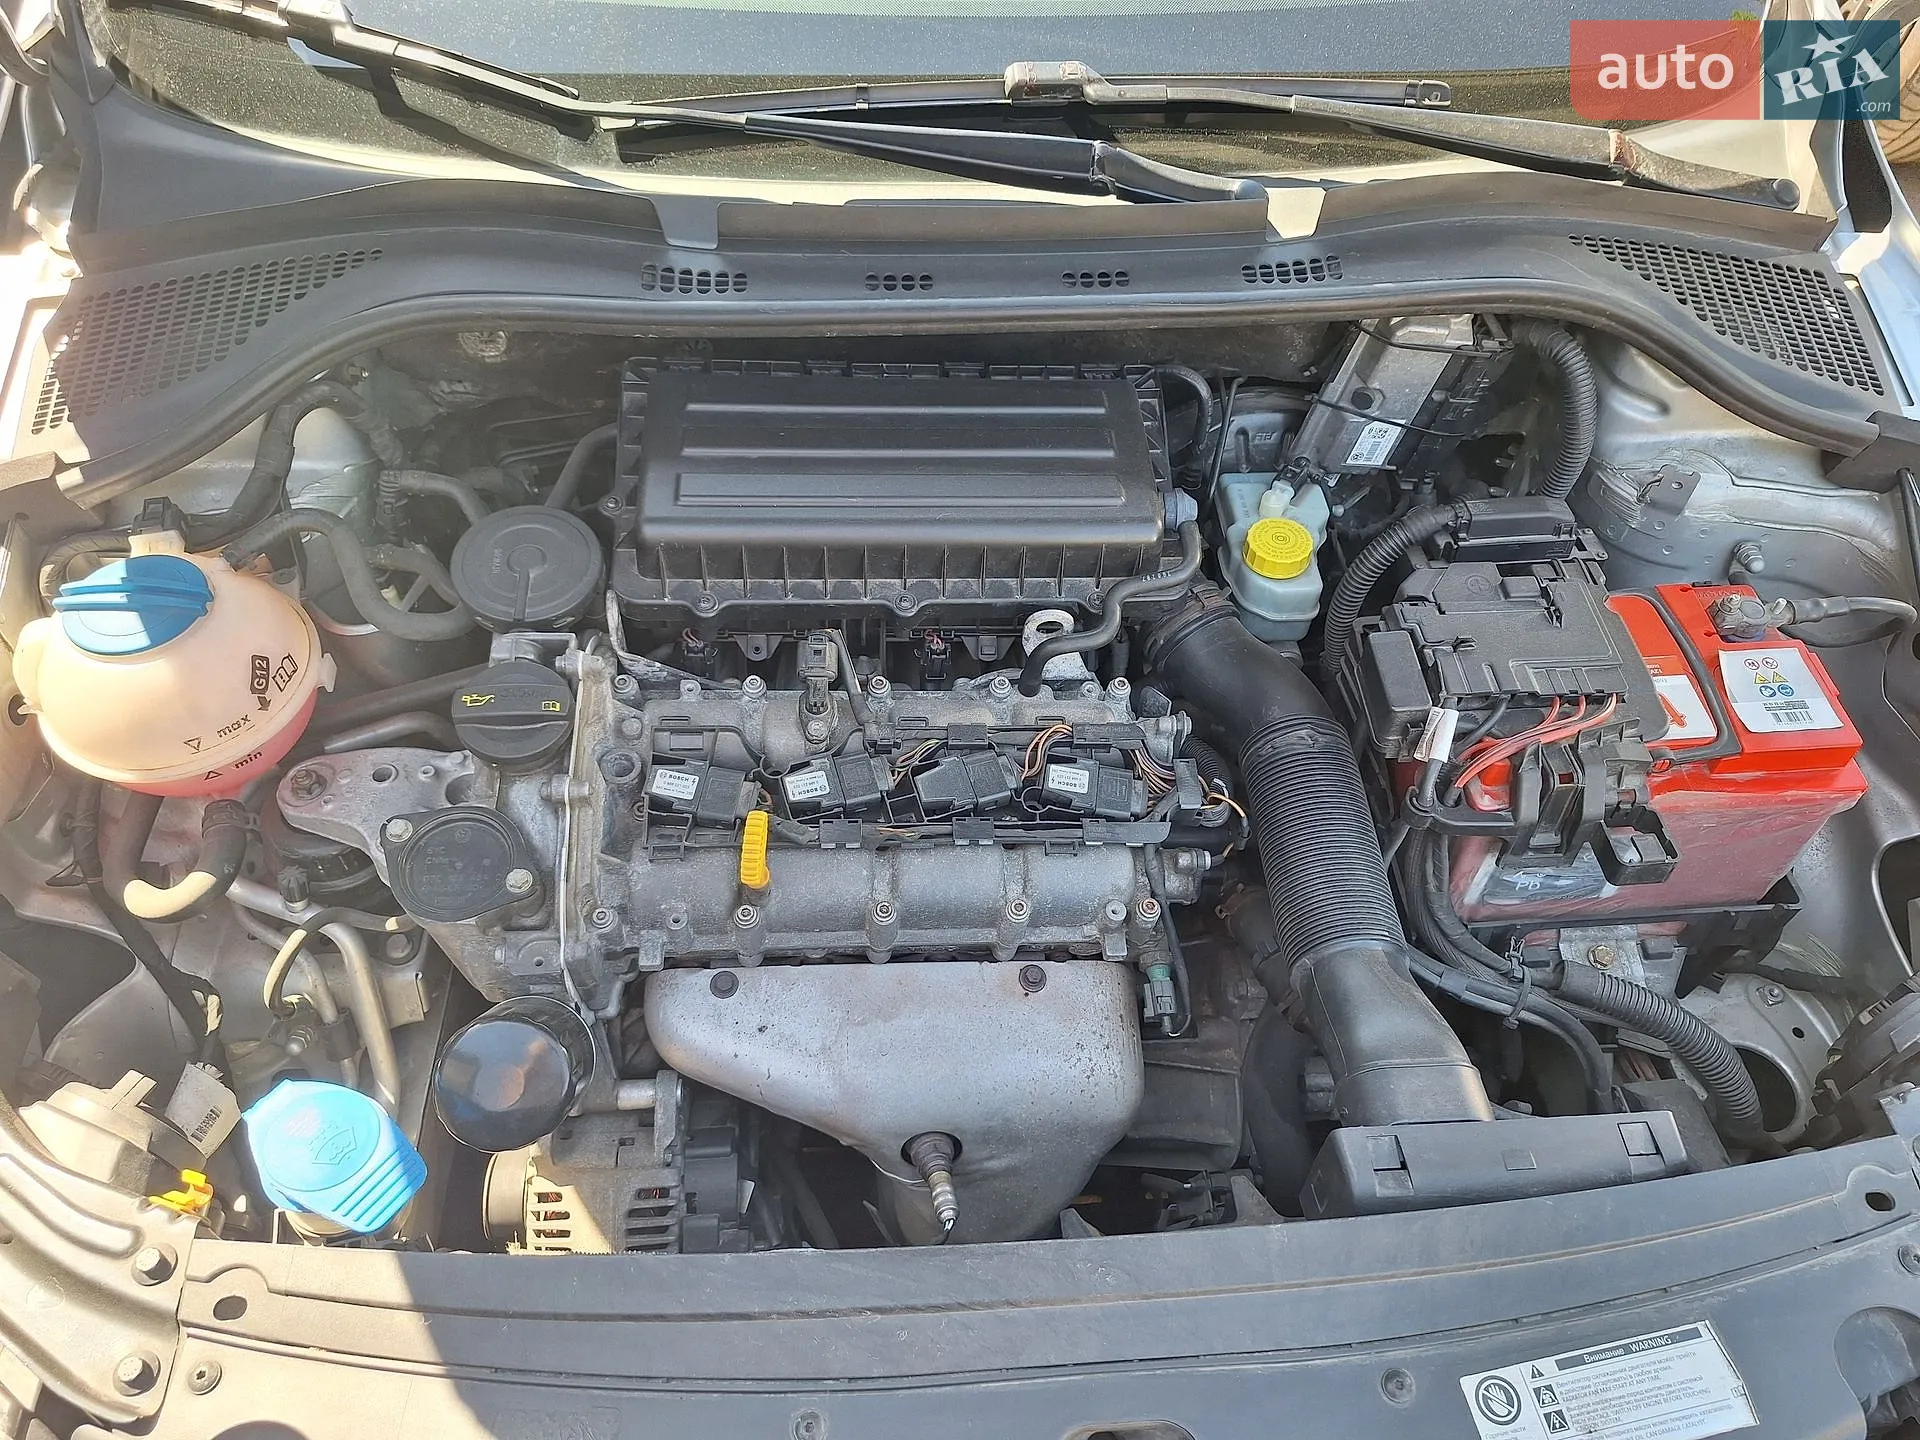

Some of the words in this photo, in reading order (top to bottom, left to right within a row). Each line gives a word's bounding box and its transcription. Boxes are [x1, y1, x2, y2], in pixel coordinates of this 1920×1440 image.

[253, 659, 267, 689] G12
[216, 714, 251, 738] max
[233, 751, 264, 769] min
[1583, 1348, 1624, 1363] Внимание
[1628, 1334, 1671, 1352] WARNING
